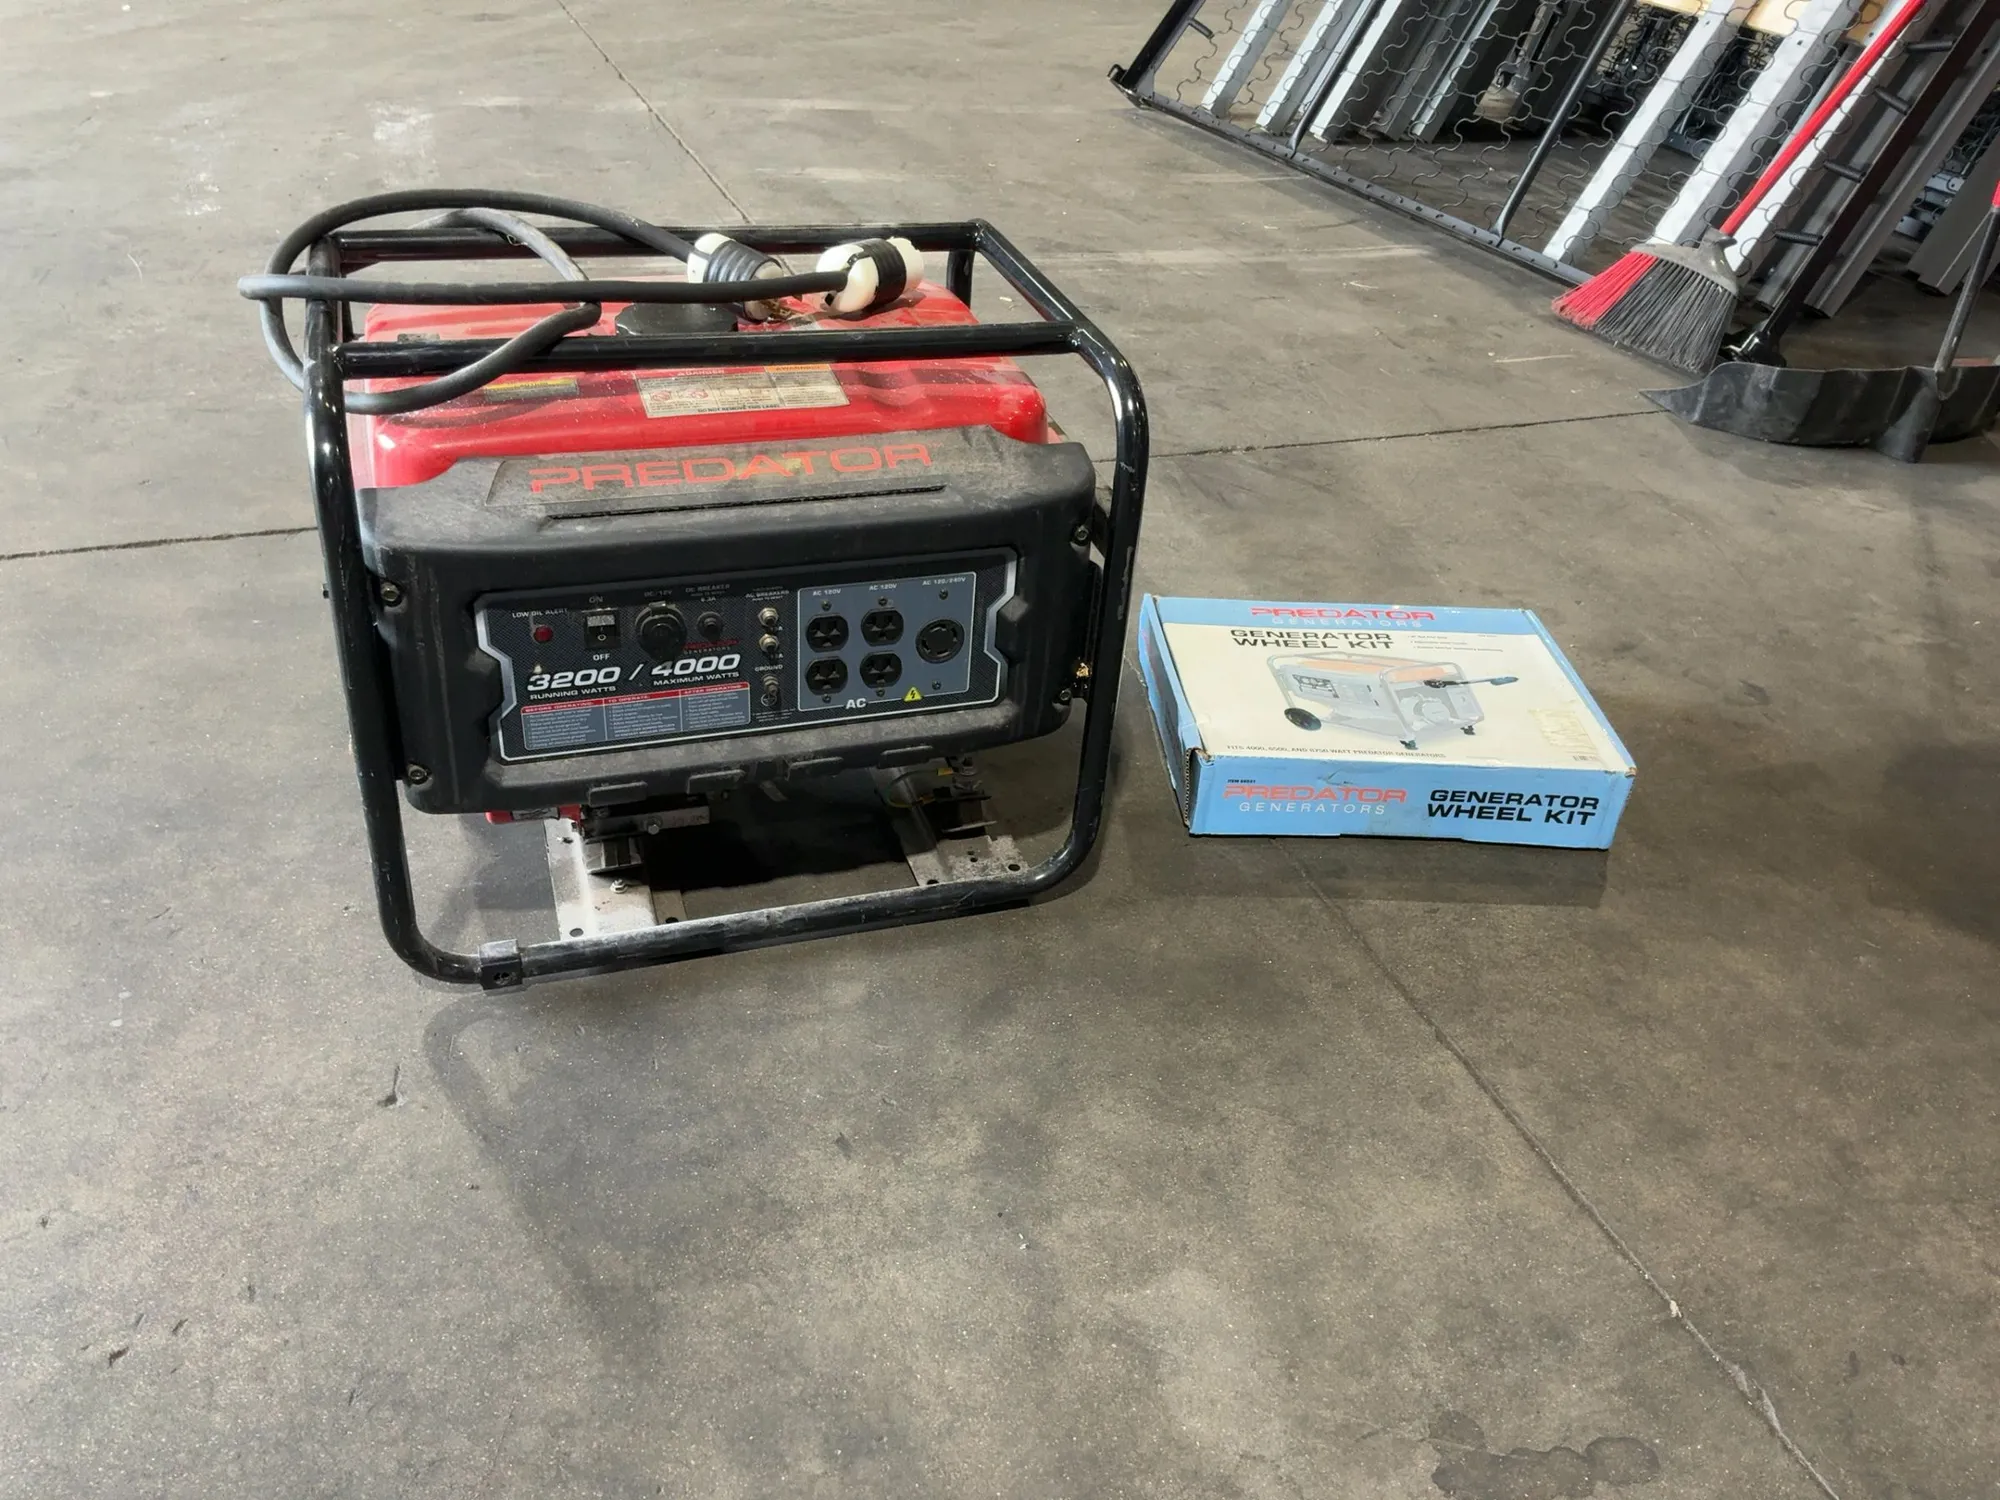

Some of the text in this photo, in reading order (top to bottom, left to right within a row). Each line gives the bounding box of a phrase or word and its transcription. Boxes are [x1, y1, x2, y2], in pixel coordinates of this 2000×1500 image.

[528, 443, 932, 493] PREDATOR
[588, 596, 604, 604] ON
[512, 611, 530, 619] LOW
[545, 607, 568, 615] ALERT
[1250, 607, 1436, 621] PREDATOR
[1271, 617, 1424, 628] GENERATORS
[1230, 629, 1392, 641] GENERATOR
[1231, 637, 1394, 650] WHEEL KIT
[592, 653, 610, 661] OFF
[526, 653, 741, 692] 3200 / 4000
[754, 664, 783, 672] GROUND
[653, 671, 741, 687] MAXIMUM WATTS
[529, 685, 617, 700] RUNNING WATTS
[846, 698, 867, 709] AC
[1223, 784, 1407, 804] PREDATOR
[1430, 789, 1600, 810] GENERATOR
[1239, 801, 1385, 815] GENERATORS
[1427, 803, 1596, 826] WHEEL KIT
